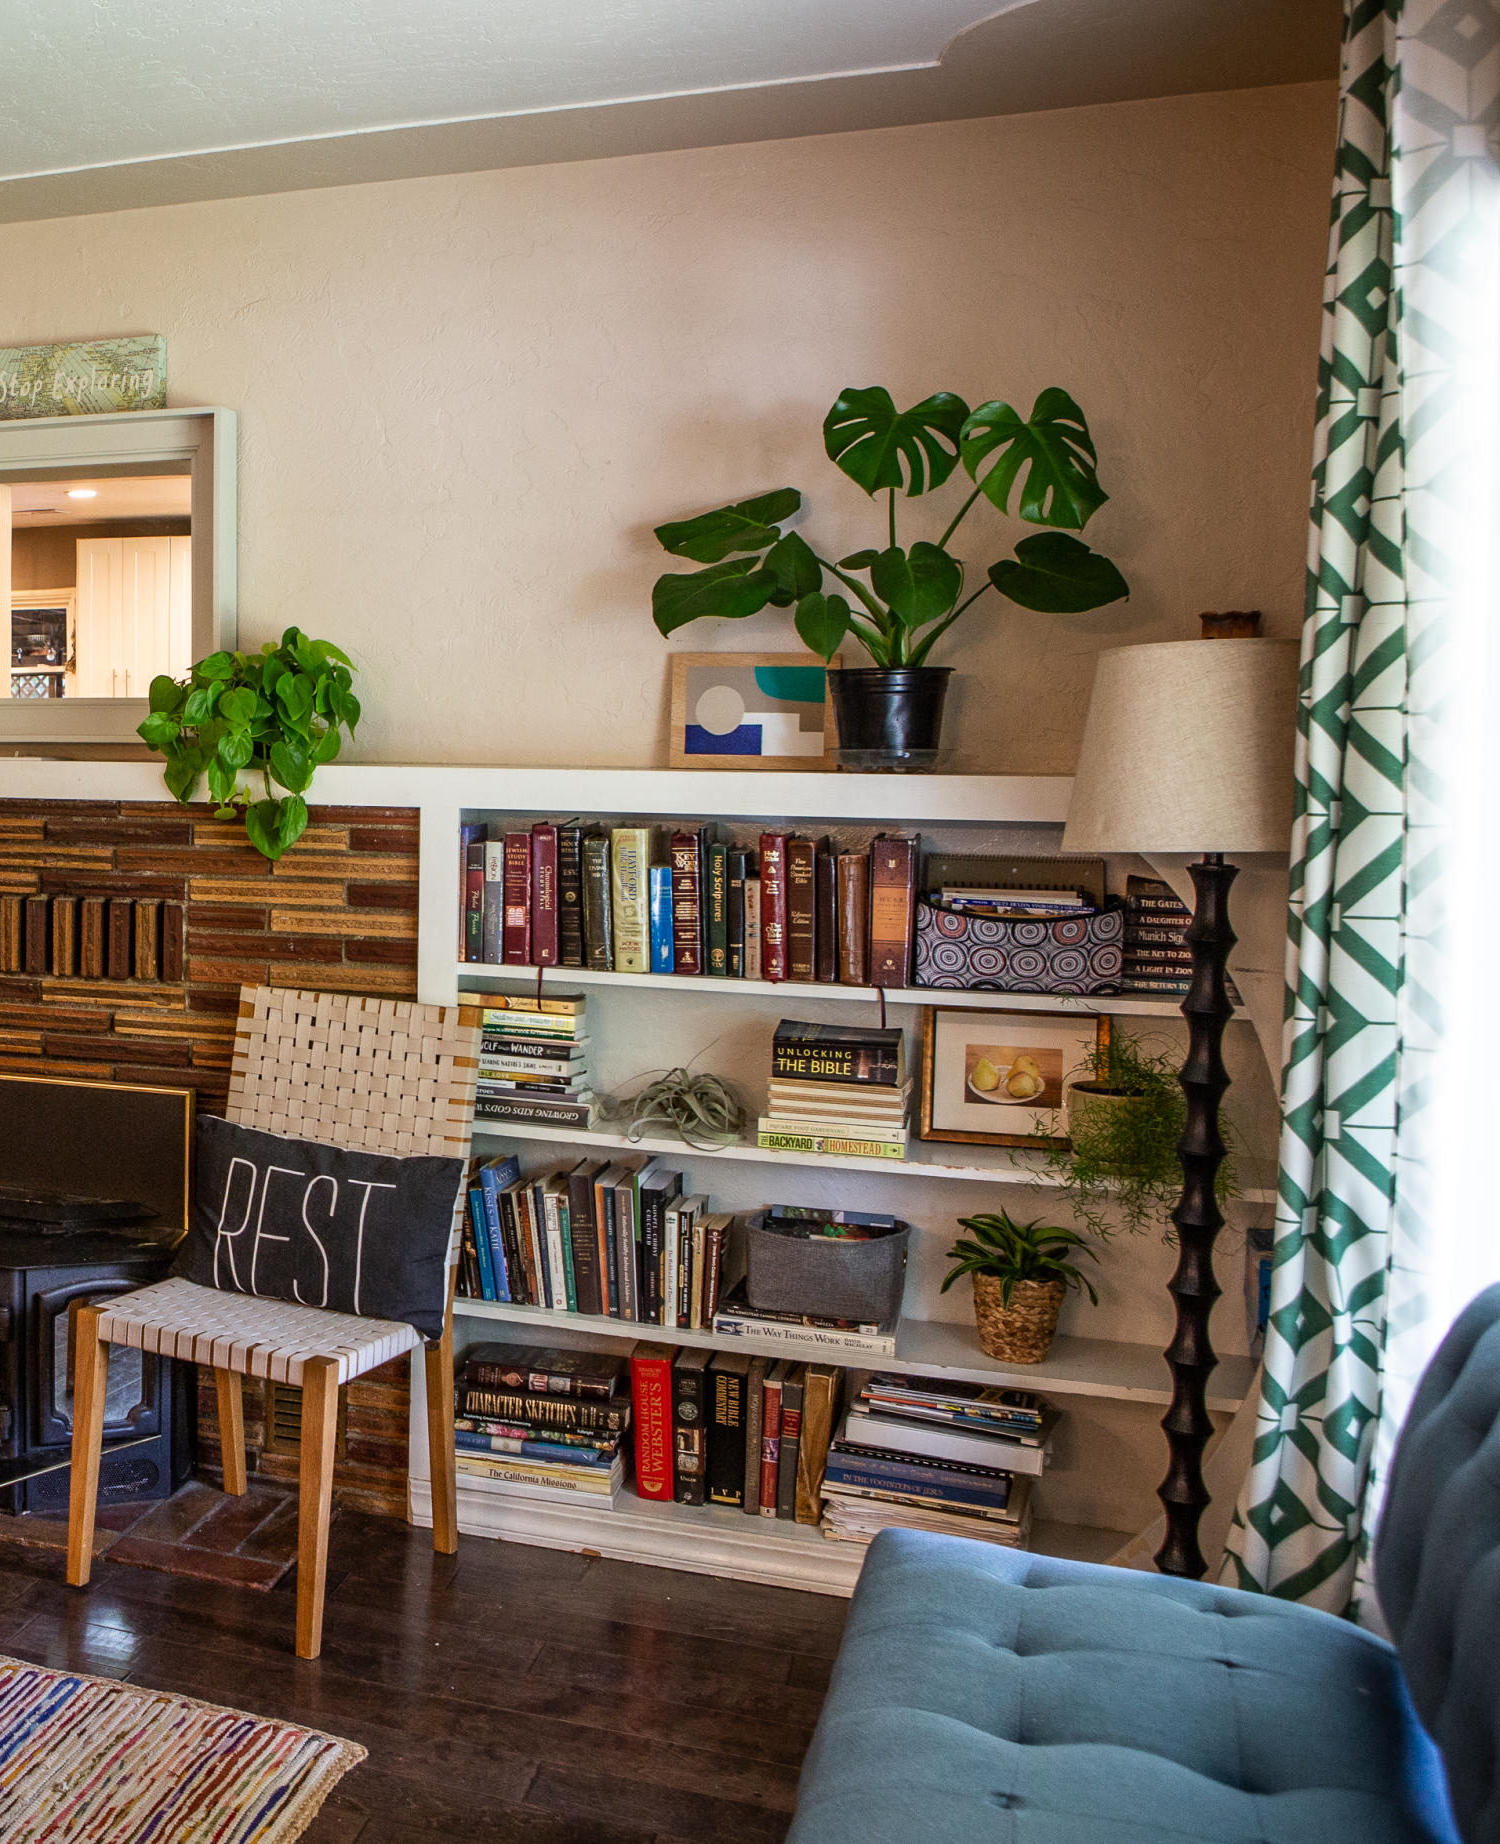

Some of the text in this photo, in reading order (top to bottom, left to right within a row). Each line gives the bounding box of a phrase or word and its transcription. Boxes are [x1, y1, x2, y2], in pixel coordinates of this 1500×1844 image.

[52, 365, 155, 401] Exploring
[627, 849, 637, 901] HAYFORD
[544, 865, 553, 911] Chronological
[711, 855, 724, 923] Holy Scriptures
[1157, 900, 1184, 909] GATES
[1146, 917, 1184, 925] DAUGHTER
[1139, 930, 1167, 942] Munich
[1178, 951, 1192, 959] ZIO
[1142, 965, 1164, 974] LIGHT
[1165, 966, 1174, 974] IN
[1149, 981, 1178, 990] RETURN
[510, 1042, 544, 1056] WANDER
[778, 1047, 852, 1059] UNLOCKING
[777, 1058, 852, 1076] THE BIBLE
[484, 1103, 512, 1114] GOD'S
[513, 1106, 534, 1117] KIDS
[534, 1108, 579, 1120] GROWING
[768, 1135, 813, 1150] BACKYARD
[829, 1140, 882, 1155] HOMESTEAD
[484, 1187, 494, 1214] KISSES
[489, 1226, 499, 1249] KATIE
[214, 1157, 396, 1316] REST
[744, 1325, 841, 1346] THE WAY THINGS WORK
[844, 1341, 873, 1350] MACAULAY
[466, 1391, 577, 1426] CHARACTER SKETCHES
[715, 1375, 728, 1427] COMMENTARY
[727, 1377, 739, 1428] NEW BIBLE
[639, 1380, 651, 1473] RANDOM HOUSE
[649, 1382, 663, 1473] WEBSTER'S
[489, 1469, 577, 1489] The California Missions
